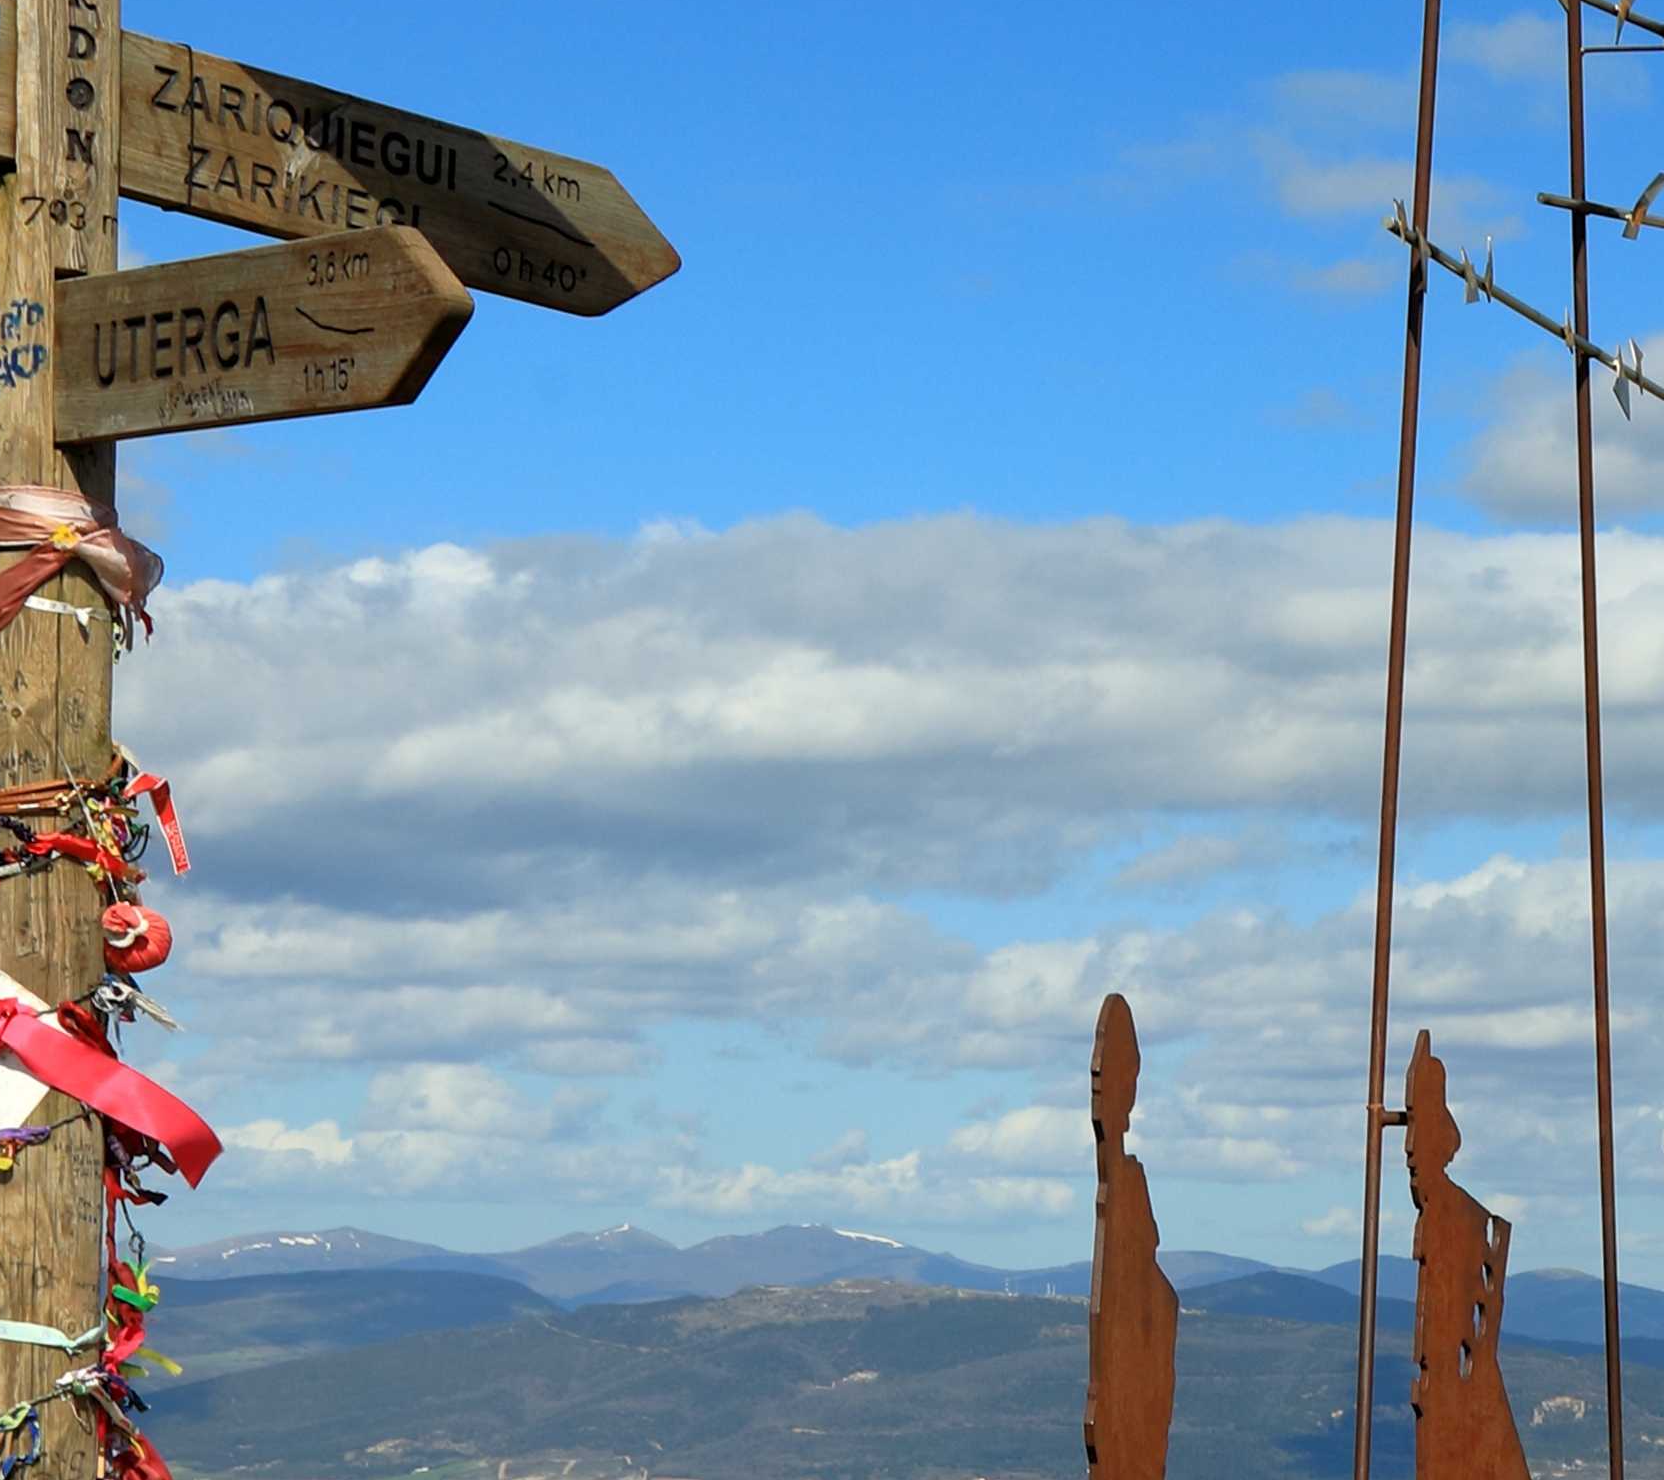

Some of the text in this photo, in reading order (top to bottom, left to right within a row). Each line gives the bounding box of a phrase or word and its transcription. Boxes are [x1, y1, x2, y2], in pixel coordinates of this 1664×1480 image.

[152, 64, 458, 191] ZARIQUIEGUI
[543, 165, 581, 202] km
[341, 250, 370, 279] km
[94, 295, 275, 387] UTERGA
